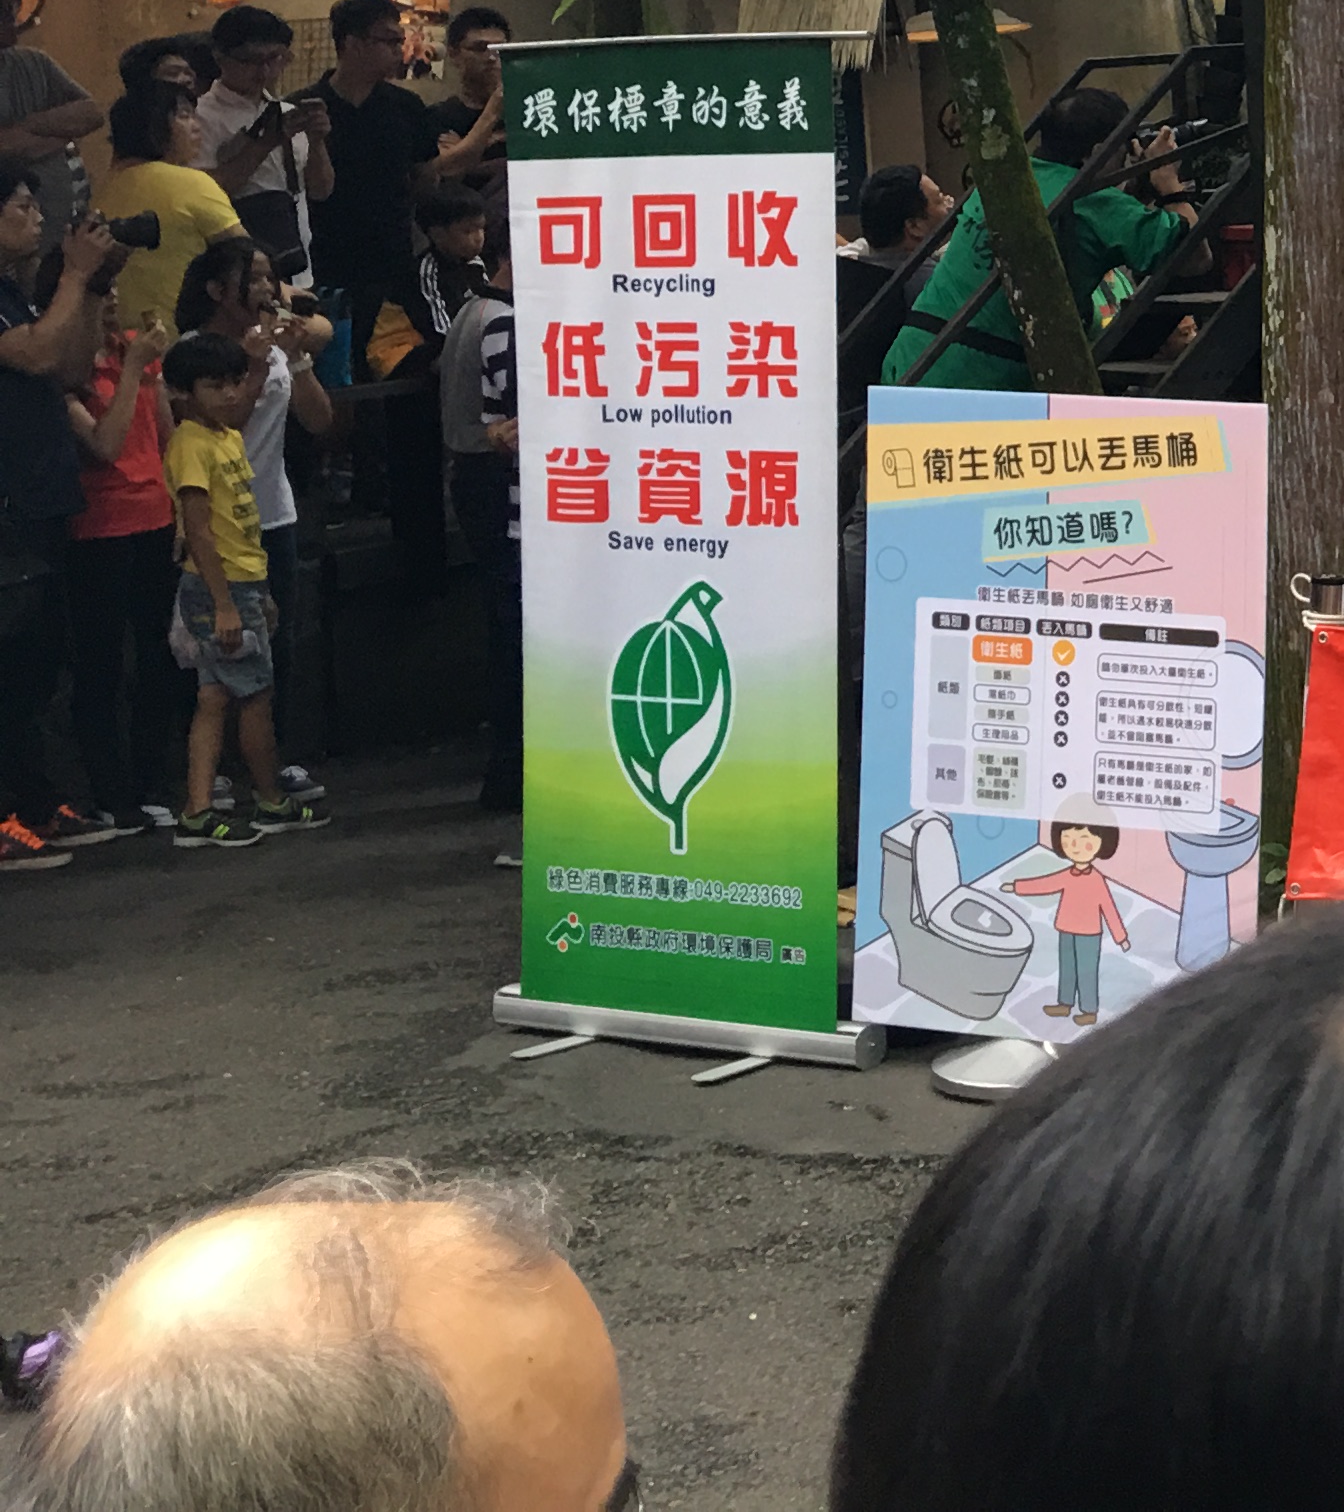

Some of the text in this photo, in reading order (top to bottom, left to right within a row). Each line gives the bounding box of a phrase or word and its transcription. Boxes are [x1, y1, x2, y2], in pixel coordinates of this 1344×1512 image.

[523, 77, 809, 138] 環保標章的意義
[536, 190, 799, 269] 可回收
[612, 274, 716, 296] Recycling
[543, 321, 798, 398] 低污染
[602, 404, 732, 426] Low pollution
[923, 431, 1198, 484] 衛生紙可以丟馬桶
[545, 448, 799, 527] 省資源
[609, 532, 729, 559] Save energy
[993, 510, 1133, 549] 你知道嗎?
[978, 587, 1174, 613] 衛生紙丟馬桶 如廁衛生又舒適
[939, 614, 1168, 643] 類別 紙類項目 丟入馬桶 備註
[980, 640, 1024, 659] 衛生紙
[935, 768, 957, 781] 其他
[590, 923, 806, 964] 南投縣政府環境保護局 廣告
